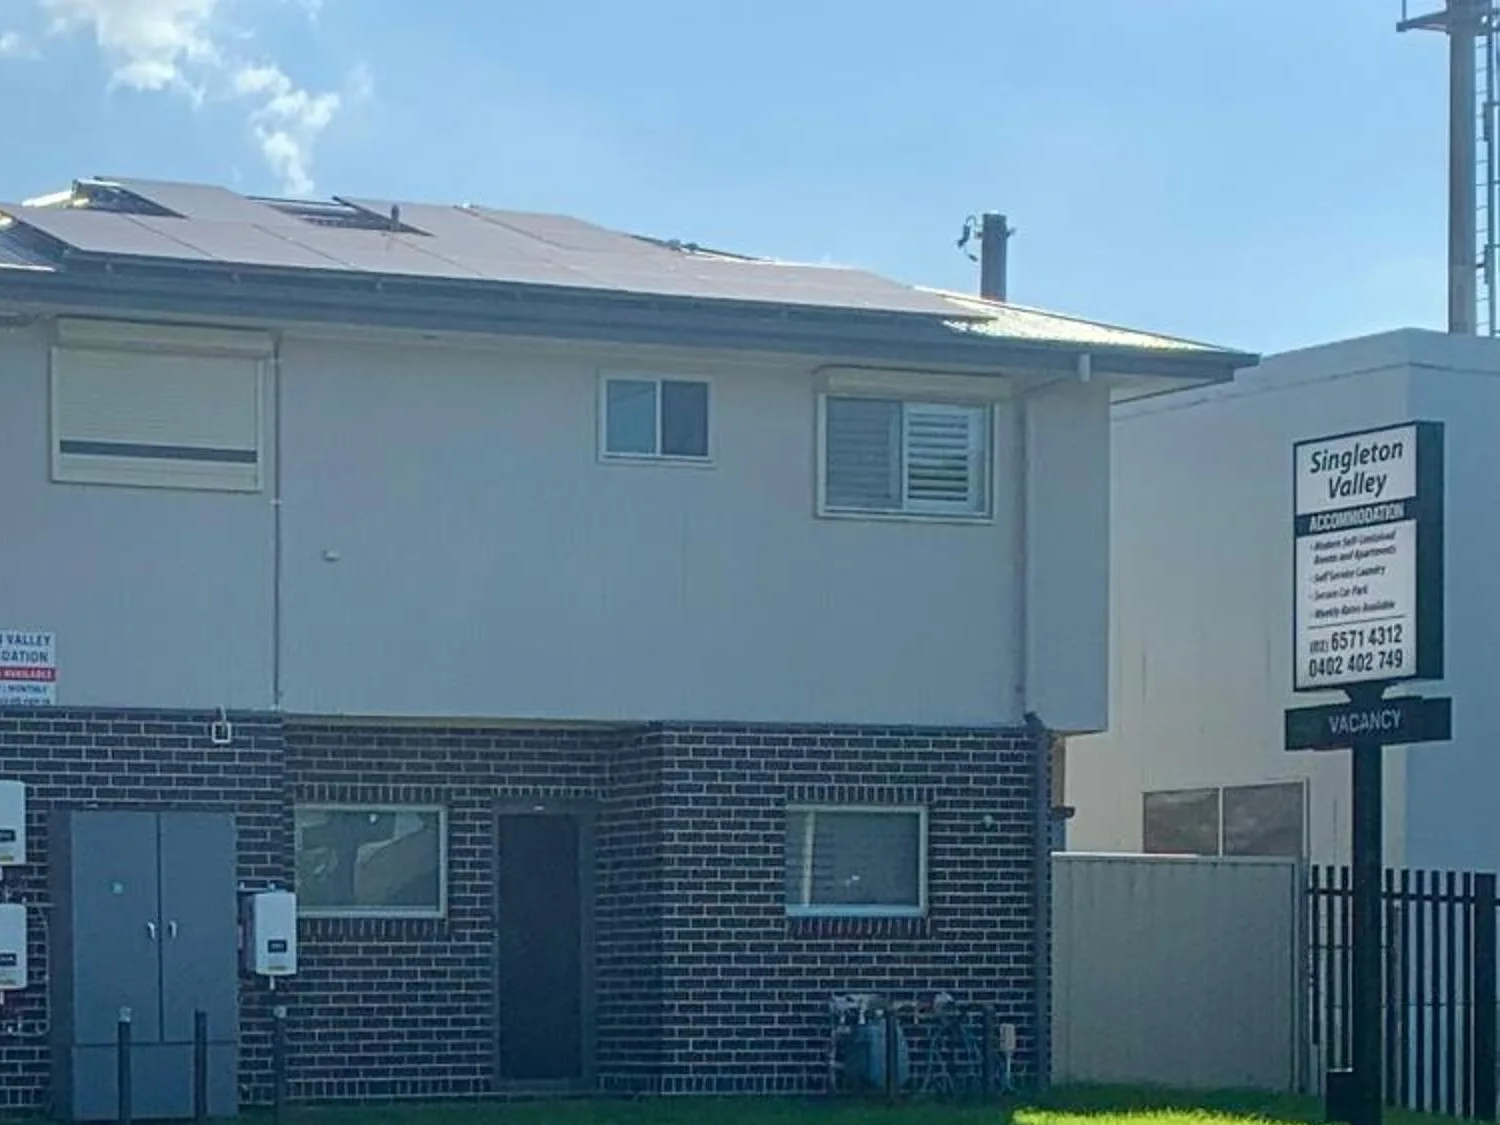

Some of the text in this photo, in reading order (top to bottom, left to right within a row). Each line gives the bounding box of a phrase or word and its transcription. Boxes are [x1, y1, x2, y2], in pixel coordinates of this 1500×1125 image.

[1310, 440, 1404, 474] Singleton
[1328, 472, 1387, 499] Valley
[1309, 503, 1404, 532] ACCOMMODATION
[1340, 586, 1350, 597] Car
[1352, 584, 1368, 595] Park
[7, 634, 51, 646] VALLEY
[1331, 629, 1364, 651] 6571
[1368, 623, 1403, 645] 4312
[1309, 648, 1403, 677] 0402 402 749
[1328, 708, 1401, 734] VACANCY
